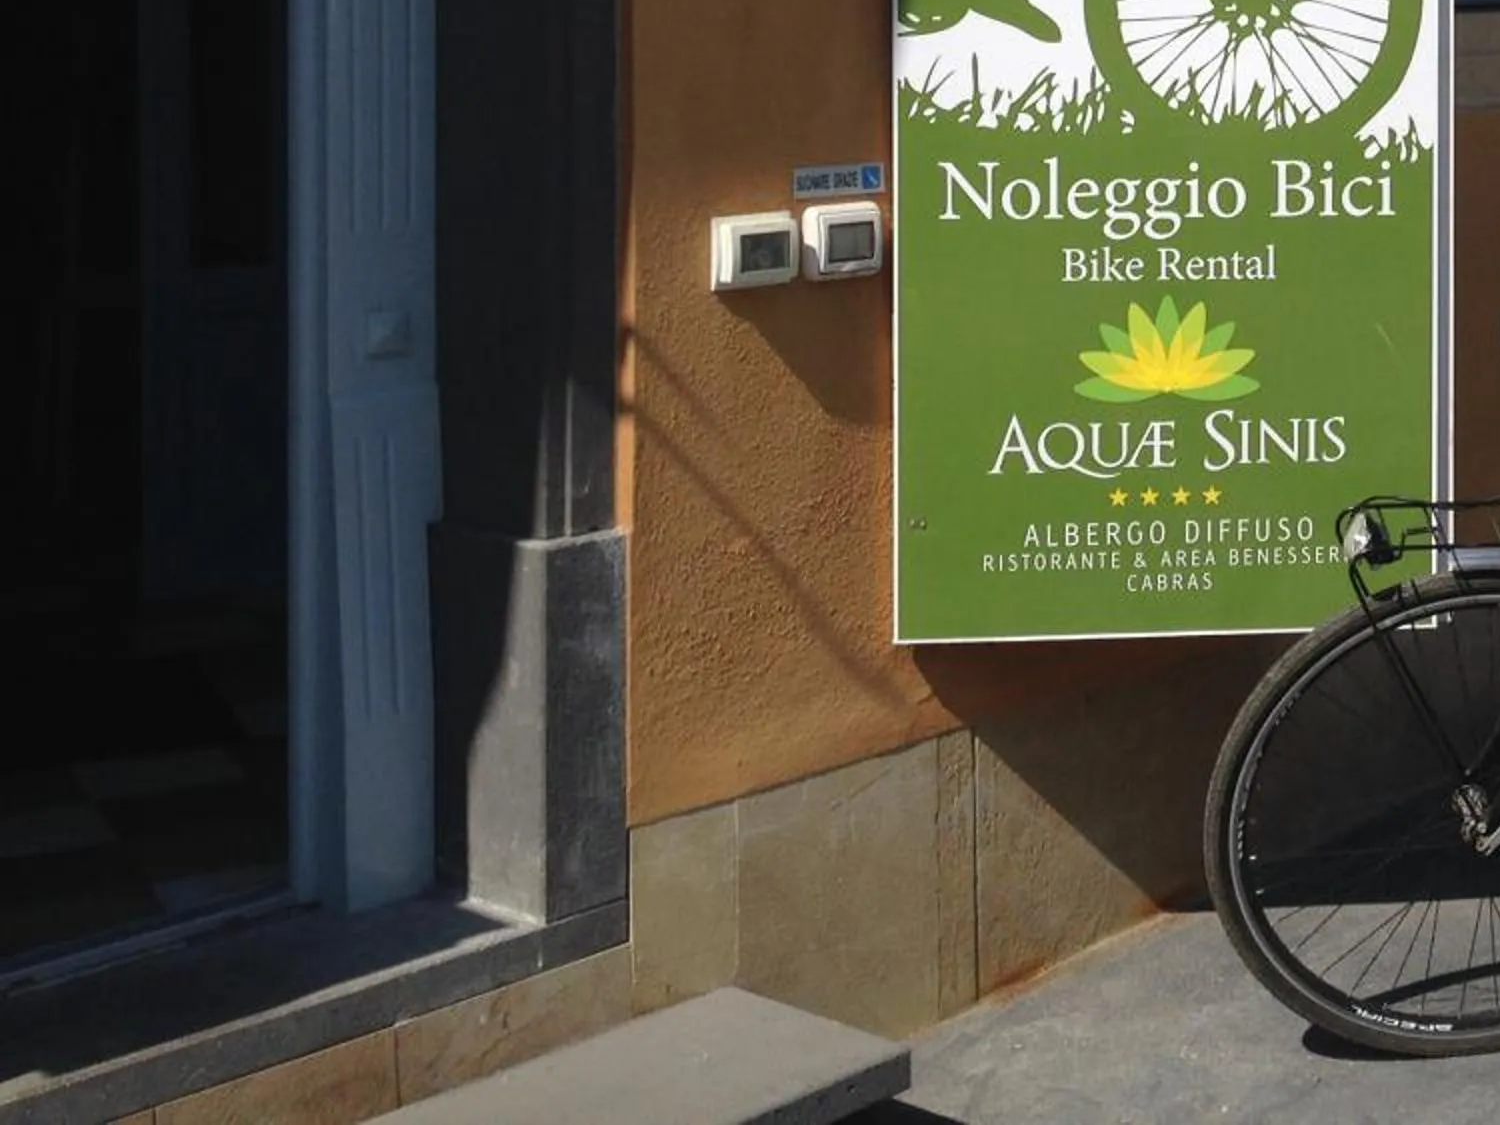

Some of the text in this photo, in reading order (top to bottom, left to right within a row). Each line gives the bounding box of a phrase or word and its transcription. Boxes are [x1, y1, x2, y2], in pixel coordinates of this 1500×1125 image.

[937, 157, 1397, 240] Noleggio Bici
[1061, 244, 1277, 282] Bike Rental
[1203, 408, 1346, 472] SINIS
[1023, 516, 1313, 548] ALBERGO DIFFUSO
[983, 545, 1348, 572] RISTORANTE & AREA BENESSER
[1127, 572, 1213, 592] CABRAS
